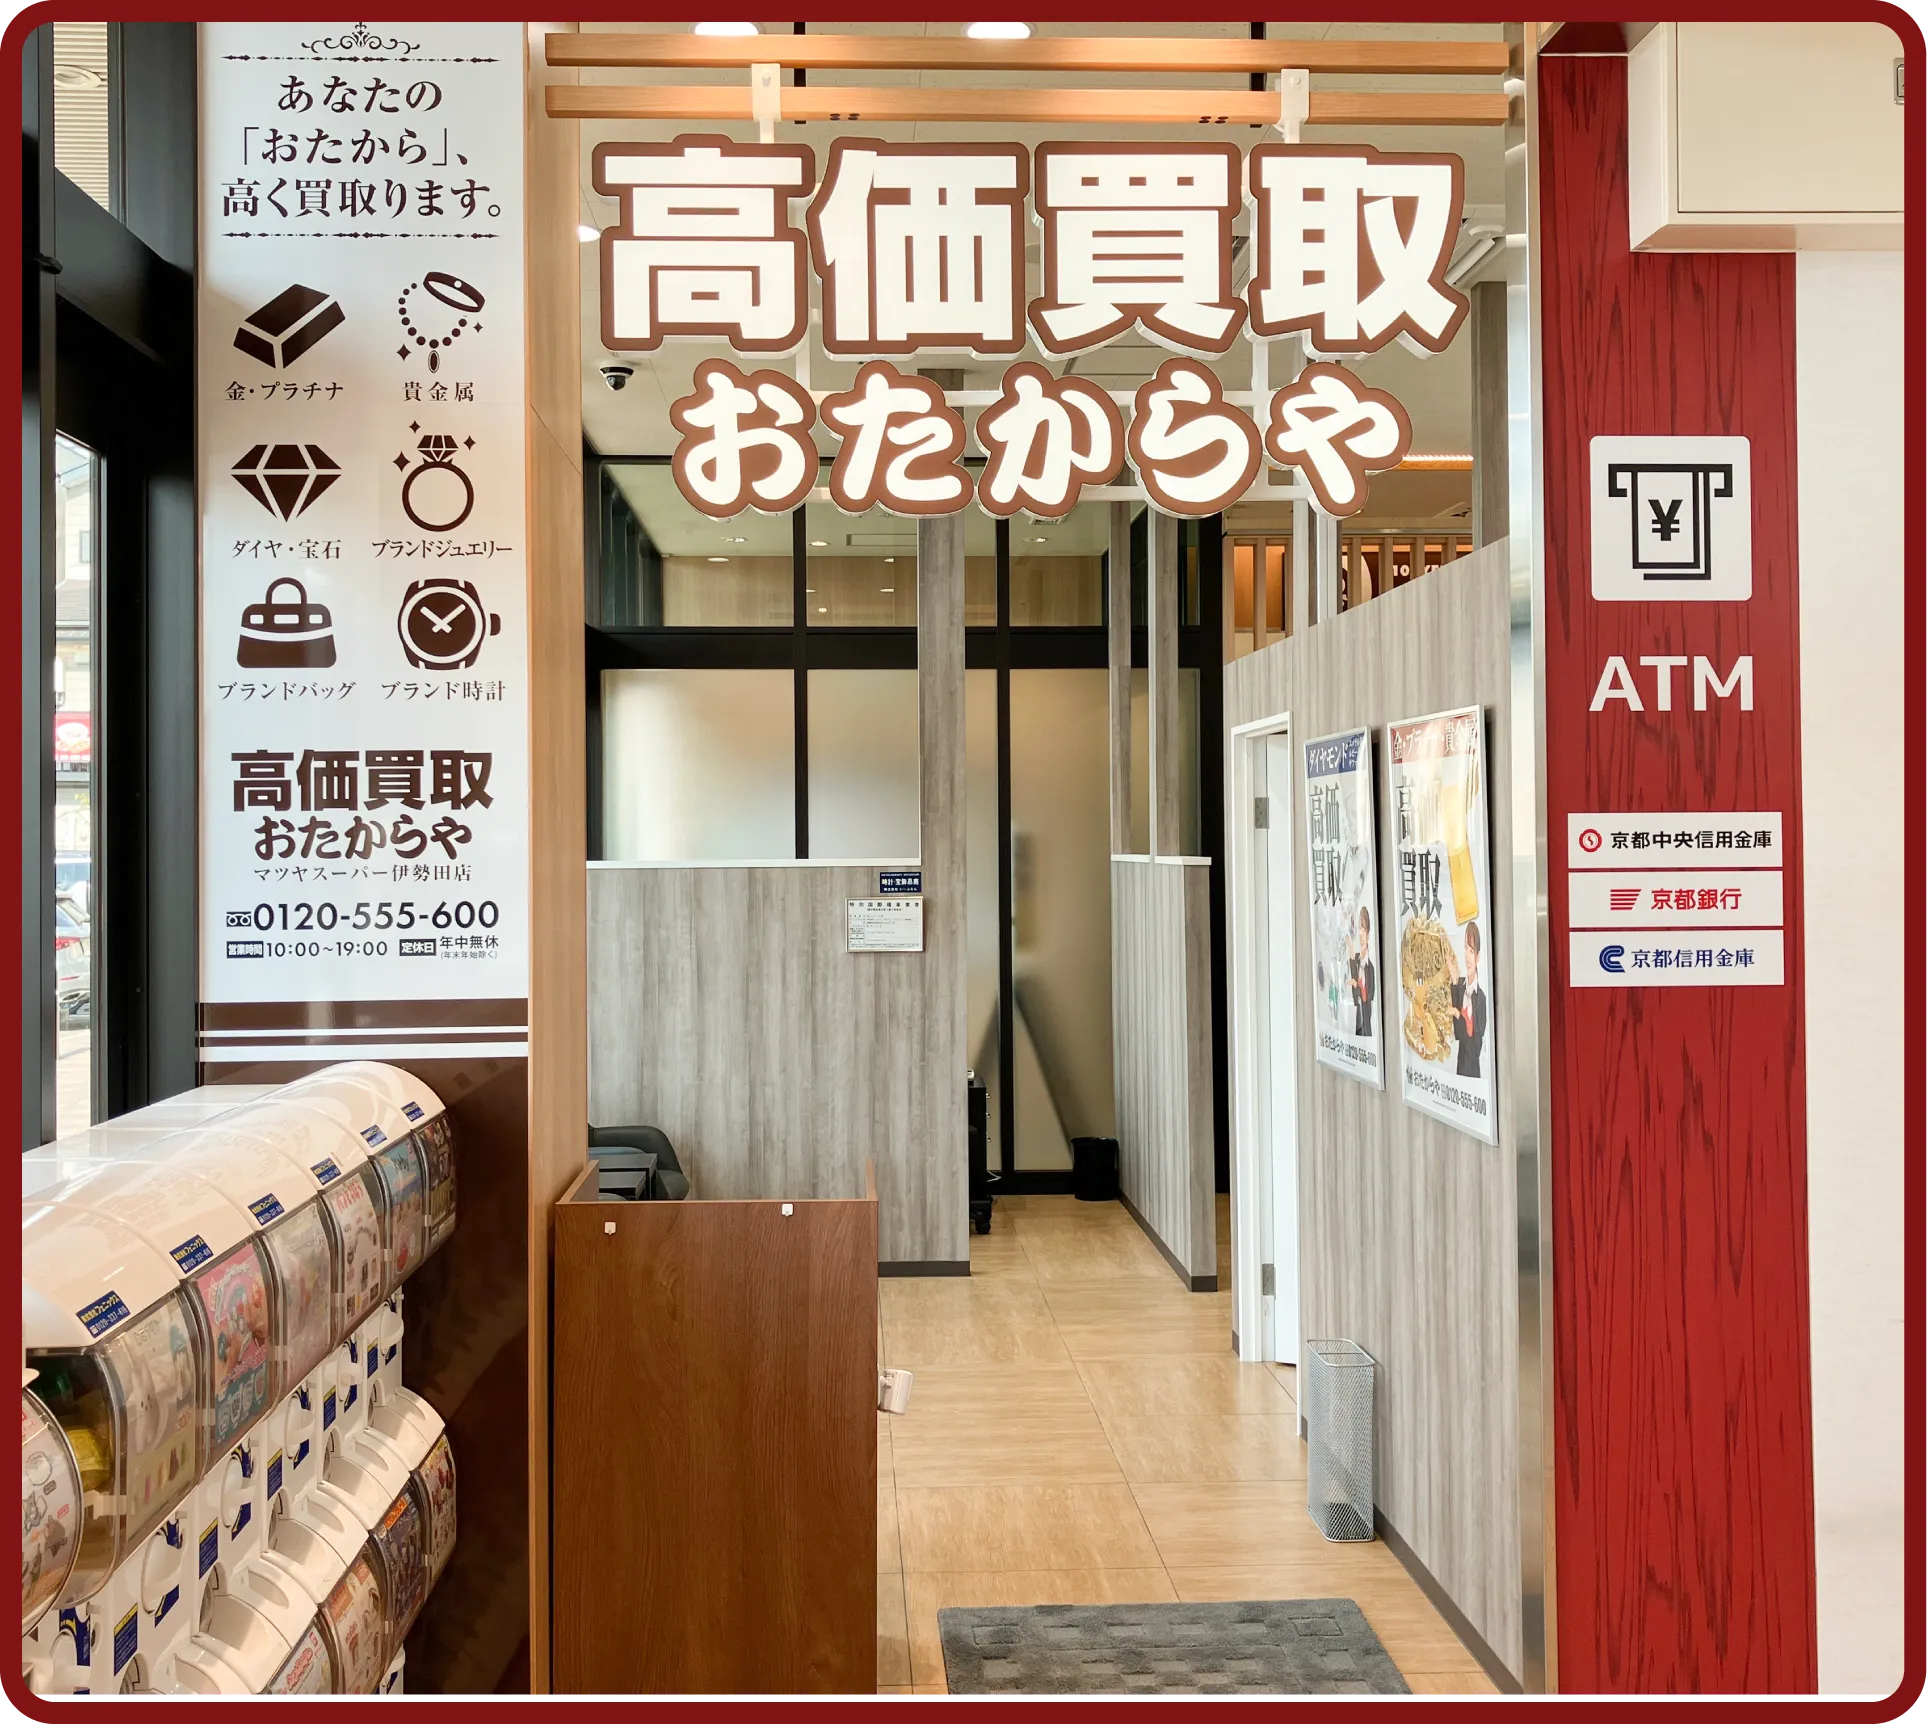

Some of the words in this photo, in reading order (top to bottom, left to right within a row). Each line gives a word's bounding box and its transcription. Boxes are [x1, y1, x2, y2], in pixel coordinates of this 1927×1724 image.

[277, 75, 443, 114] あなたの
[244, 126, 468, 167] 「おたから」、
[221, 177, 501, 219] 高く買取ります。
[600, 144, 1460, 345] 高価買取
[224, 380, 344, 401] 金・プラチナ
[402, 381, 475, 402] 貴金属
[680, 366, 1402, 508] おたからや
[232, 539, 342, 559] ダイヤ・宝石
[371, 539, 513, 558] ブランドジュエリー
[218, 681, 357, 701] ブランドバッグ
[381, 680, 506, 701] ブランド時計
[1588, 655, 1754, 712] ATM
[1309, 742, 1349, 774] ダイヤモンド
[231, 749, 494, 812] 高価買取
[254, 814, 473, 860] おたからや
[1610, 829, 1772, 850] 京都中央信用金庫
[253, 864, 472, 882] マツヤスーパー伊勢田店
[1312, 846, 1342, 907] 買取
[1400, 848, 1442, 921] 買取
[1651, 888, 1742, 911] 京都銀行
[253, 900, 499, 931] 0120-555-600
[228, 942, 263, 957] 営業時間
[401, 941, 435, 954] 定休日
[439, 935, 499, 949] 年中無休
[1631, 948, 1755, 969] 京都信用金庫
